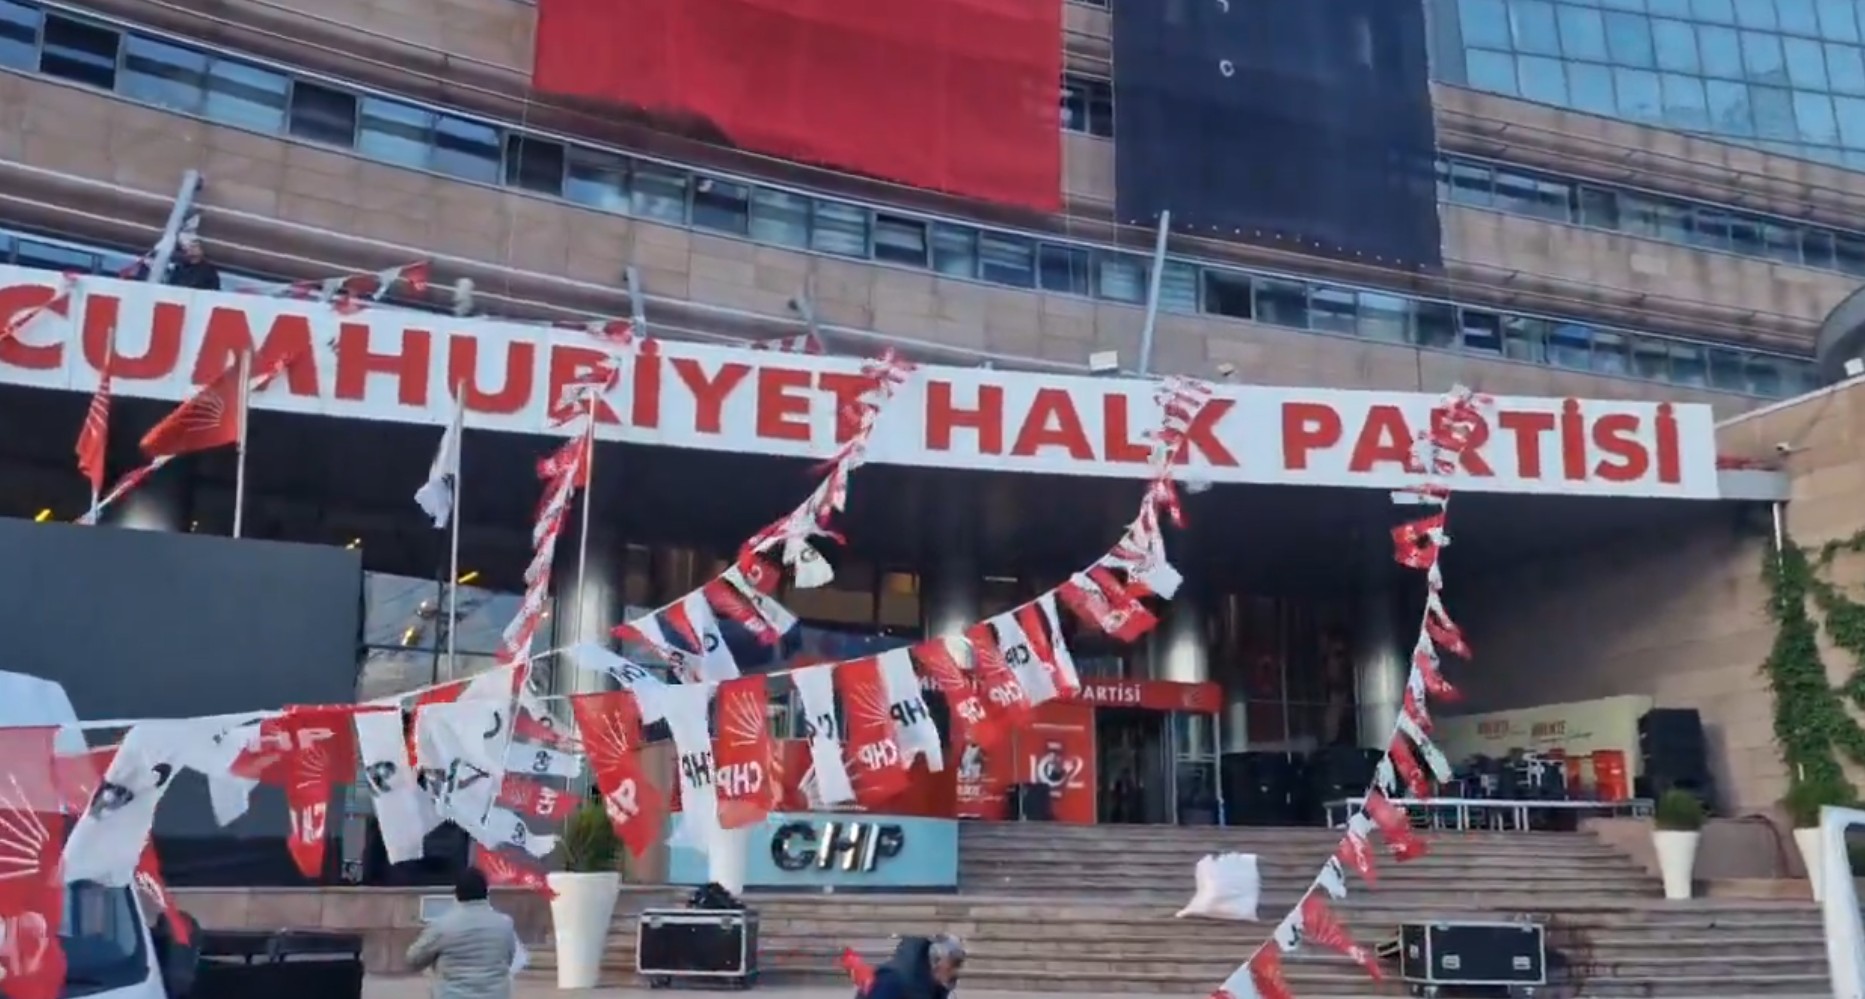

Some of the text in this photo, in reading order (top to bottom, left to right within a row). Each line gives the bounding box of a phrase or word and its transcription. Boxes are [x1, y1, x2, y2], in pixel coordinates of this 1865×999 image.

[0, 284, 1682, 484] CUMHURİYET HALK PARTİSİ
[1073, 683, 1141, 702] ARTİSİ
[771, 821, 904, 872] CHP
